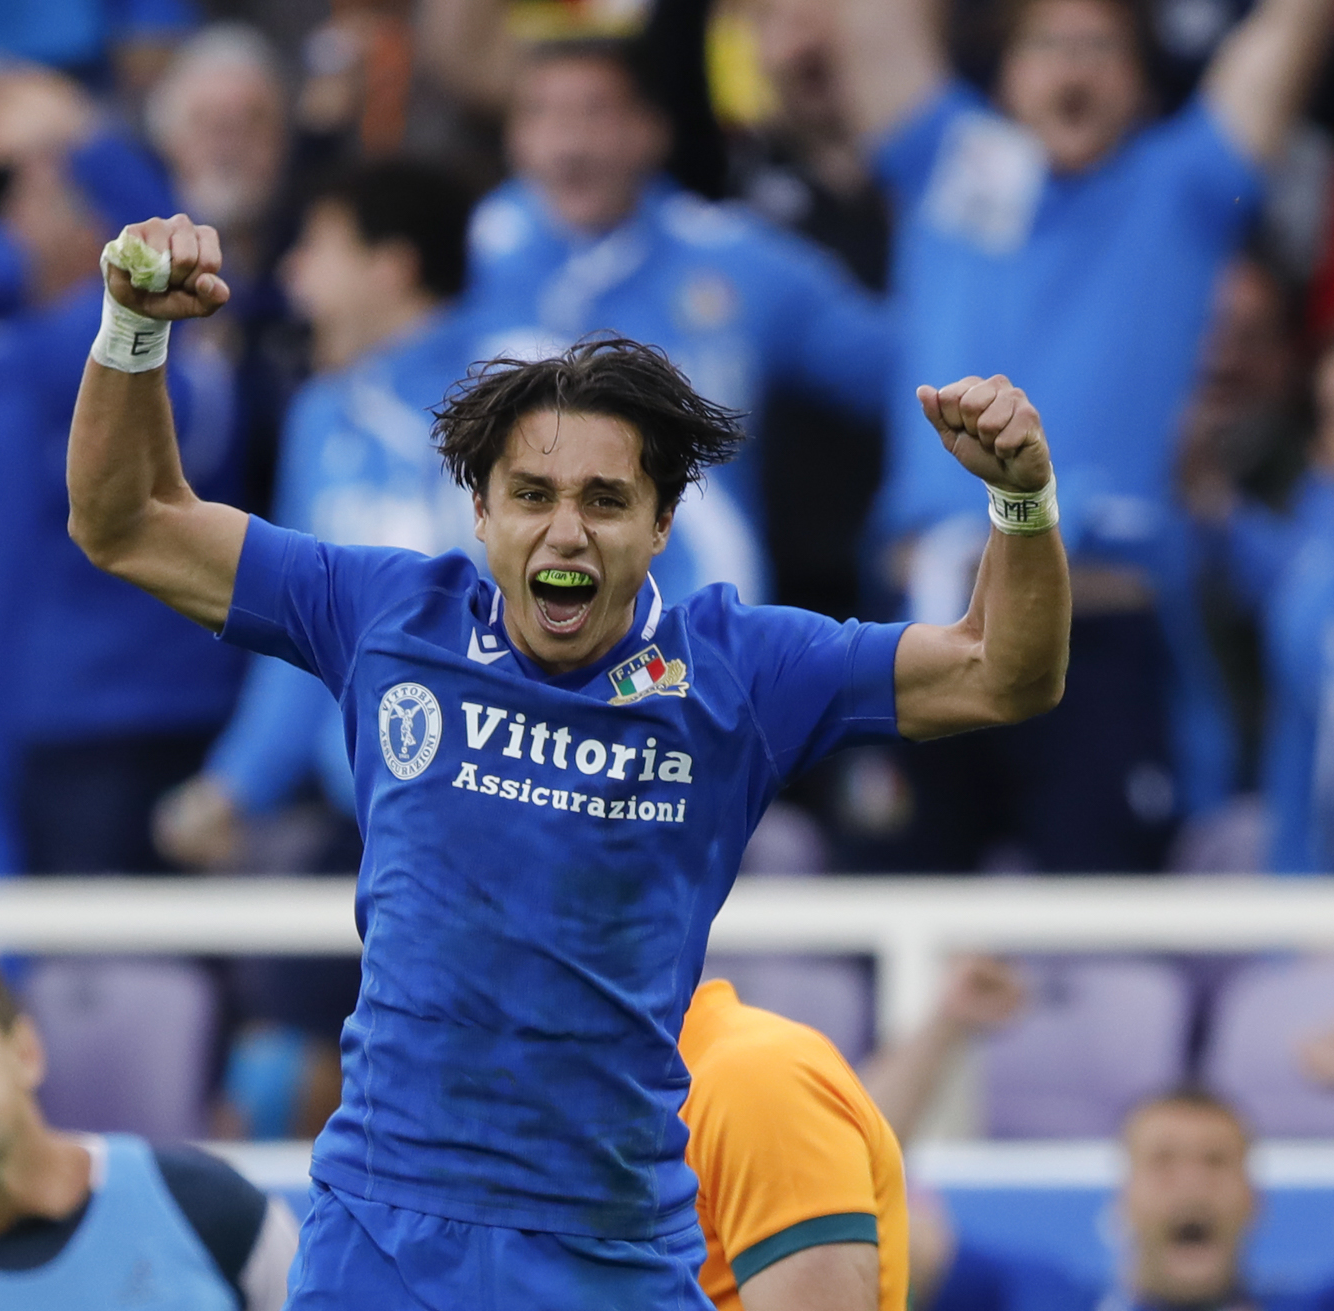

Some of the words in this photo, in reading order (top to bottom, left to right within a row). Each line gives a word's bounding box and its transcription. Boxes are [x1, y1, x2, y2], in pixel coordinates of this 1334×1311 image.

[131, 331, 156, 356] E
[461, 701, 694, 784] Vittoria
[452, 762, 687, 823] Assicurazioni
